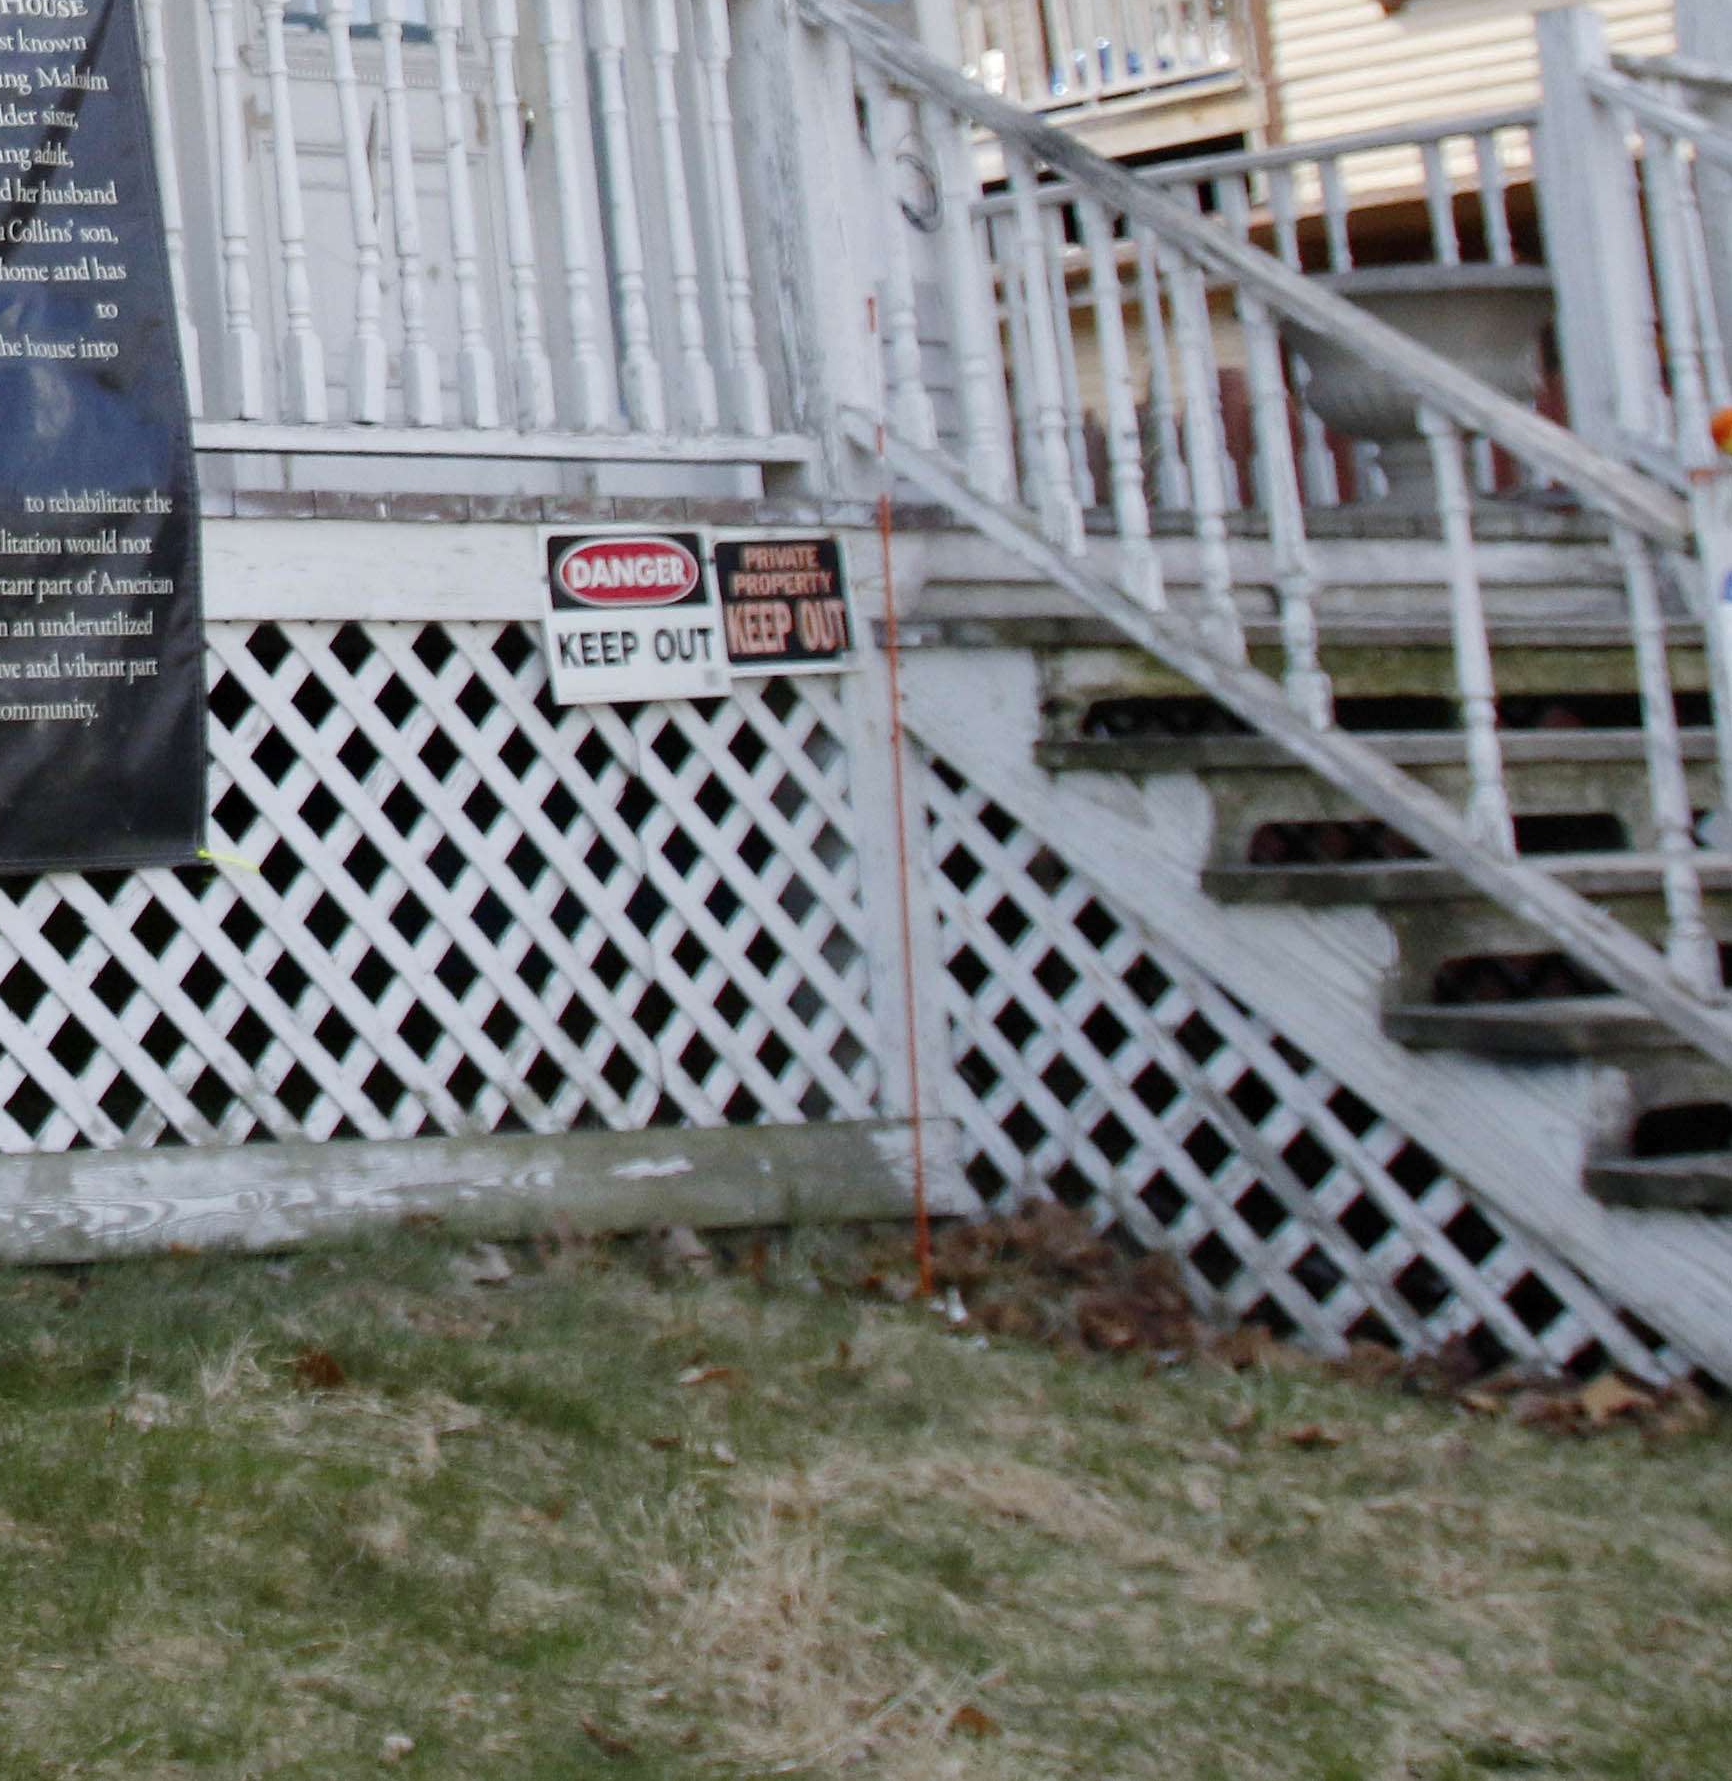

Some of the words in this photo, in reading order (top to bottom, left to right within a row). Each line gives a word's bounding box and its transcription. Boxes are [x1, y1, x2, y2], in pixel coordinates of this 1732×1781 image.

[18, 28, 87, 54] known
[33, 143, 74, 168] adult,
[16, 179, 38, 203] her
[40, 180, 118, 205] husband
[7, 218, 73, 243] Collins'
[80, 225, 119, 245] son,
[53, 259, 88, 281] and
[94, 257, 127, 280] has
[96, 301, 118, 318] to
[26, 334, 76, 359] house
[80, 333, 119, 361] into
[24, 496, 45, 514] to
[48, 490, 142, 514] rehabilitate
[145, 490, 173, 514] the
[65, 529, 117, 555] would
[119, 535, 153, 555] not
[741, 545, 820, 570] PRIVATE
[568, 554, 688, 588] DANGER
[729, 570, 832, 596] PROPERTY
[37, 576, 73, 603] part
[75, 571, 96, 596] of
[99, 573, 174, 595] American
[11, 621, 36, 637] an
[39, 611, 154, 637] underutilized
[726, 599, 794, 654] KEEP
[797, 598, 848, 652] OUT
[557, 629, 640, 668] KEEP
[653, 627, 715, 663] OUT
[25, 652, 61, 679] and
[64, 653, 126, 678] vibrant
[129, 657, 158, 686] part
